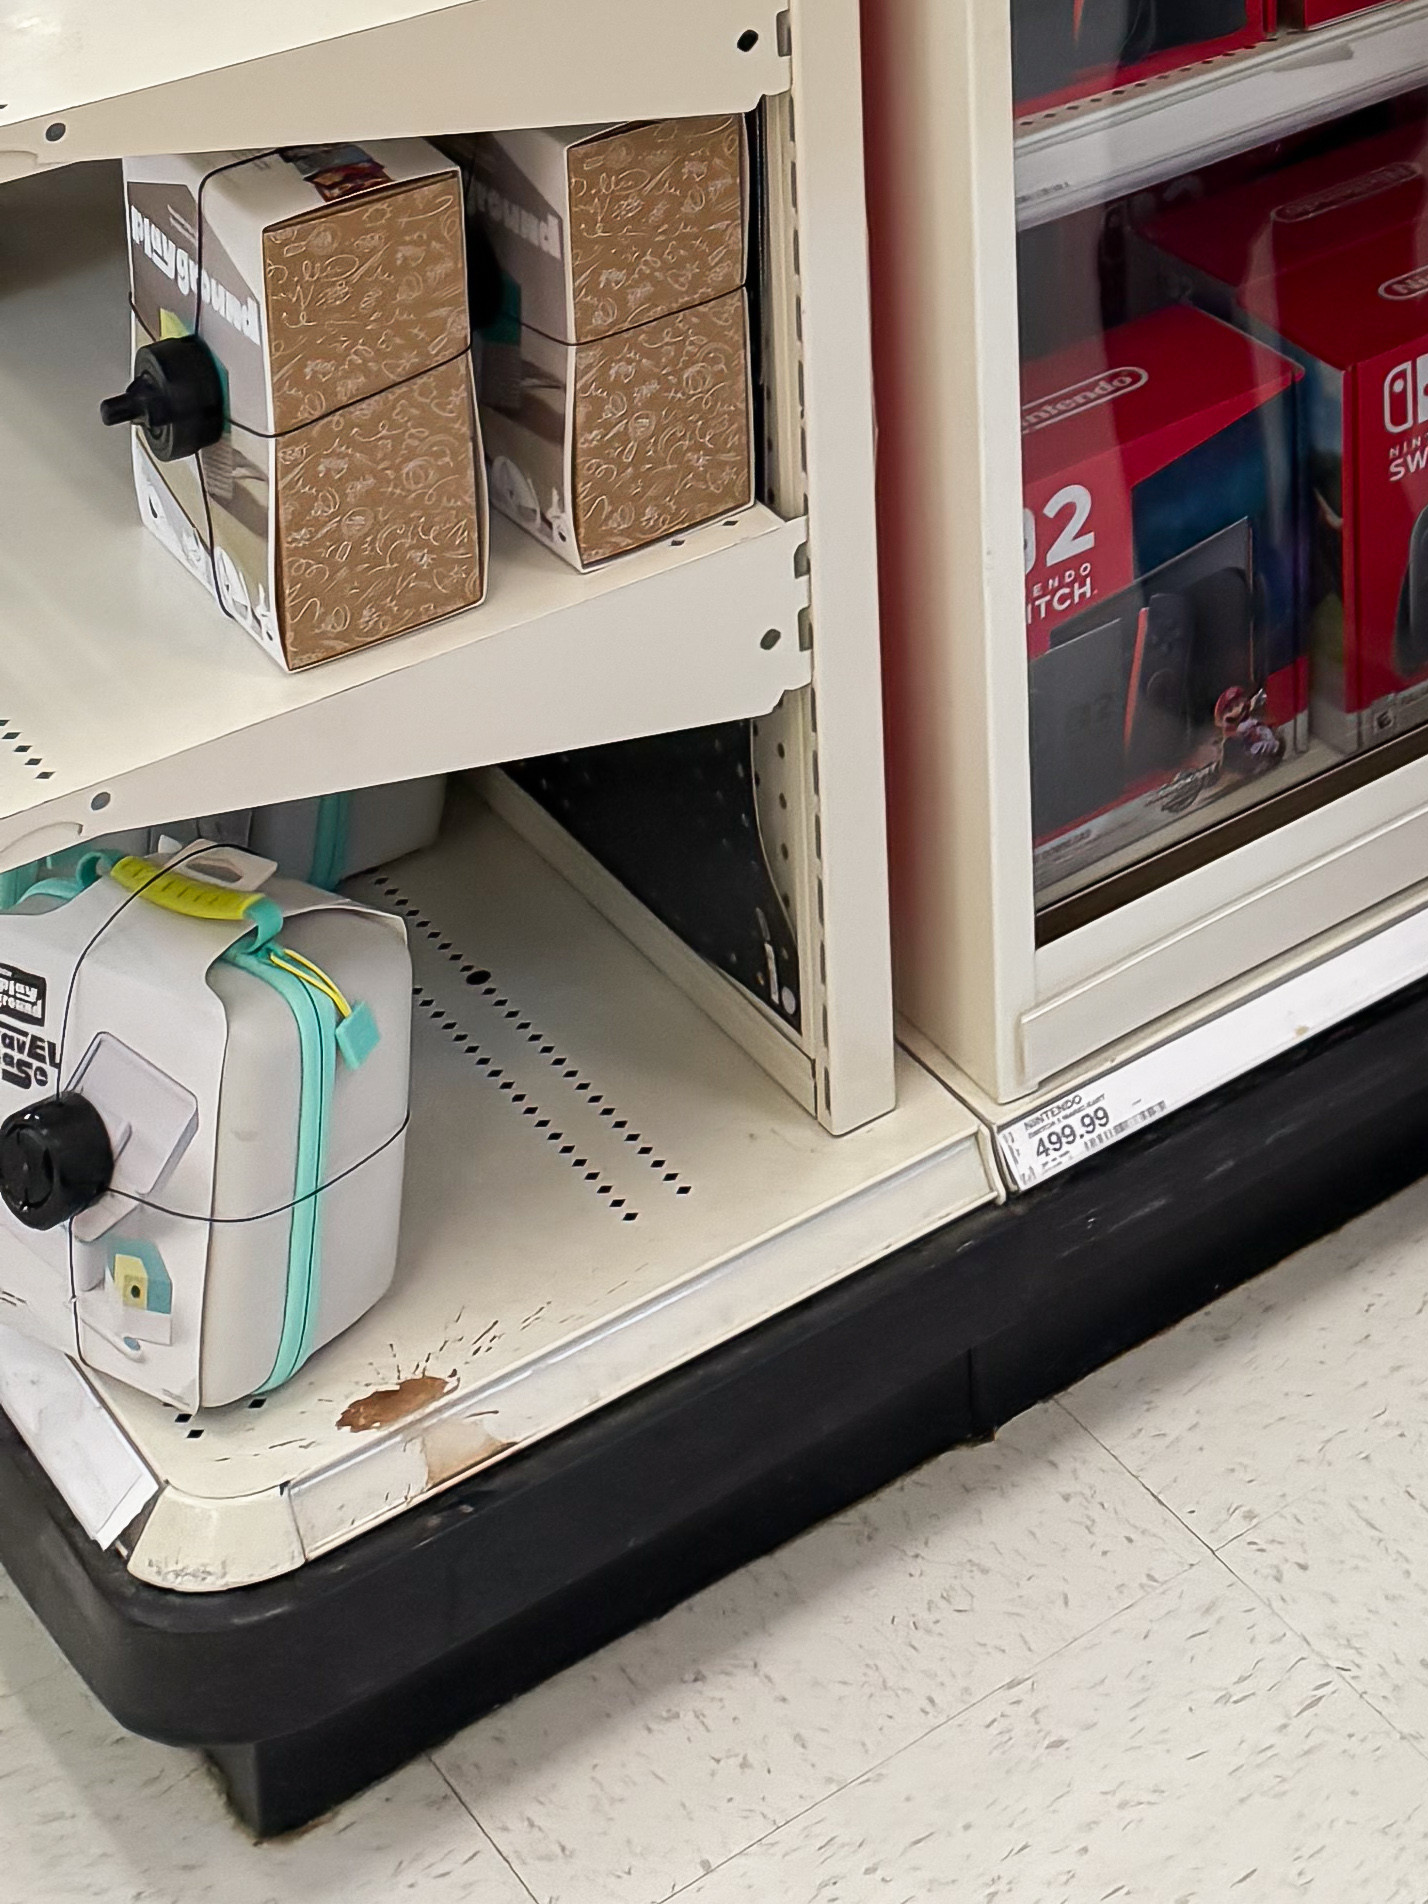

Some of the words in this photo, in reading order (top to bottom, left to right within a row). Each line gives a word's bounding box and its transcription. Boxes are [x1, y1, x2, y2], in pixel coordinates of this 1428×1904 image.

[1043, 484, 1095, 568] 2
[1024, 1094, 1083, 1131] NINTENDO
[1036, 1106, 1110, 1159] 499.99
